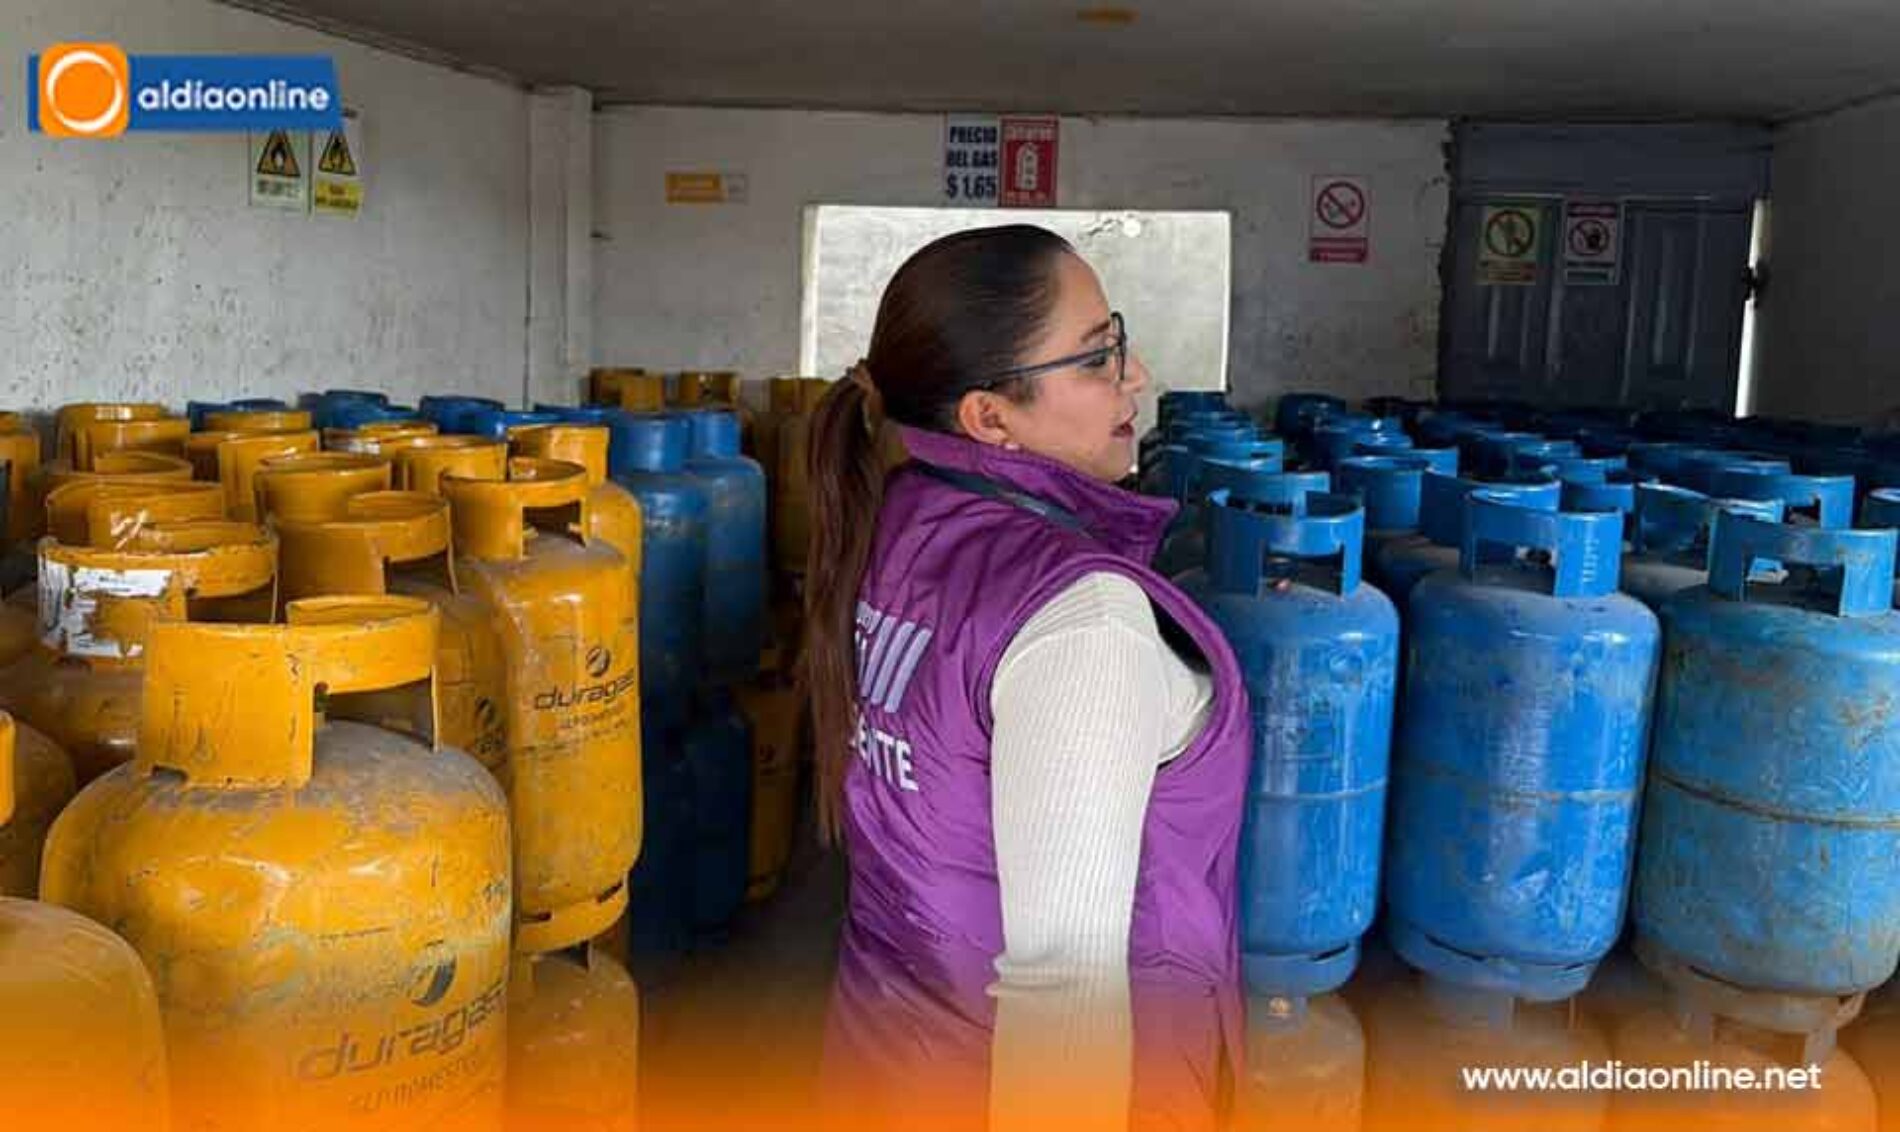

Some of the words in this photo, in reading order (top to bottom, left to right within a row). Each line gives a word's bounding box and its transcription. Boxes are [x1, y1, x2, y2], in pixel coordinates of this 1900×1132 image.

[949, 125, 998, 144] PRECIO
[946, 149, 967, 168] DEL
[971, 149, 998, 168] GAS
